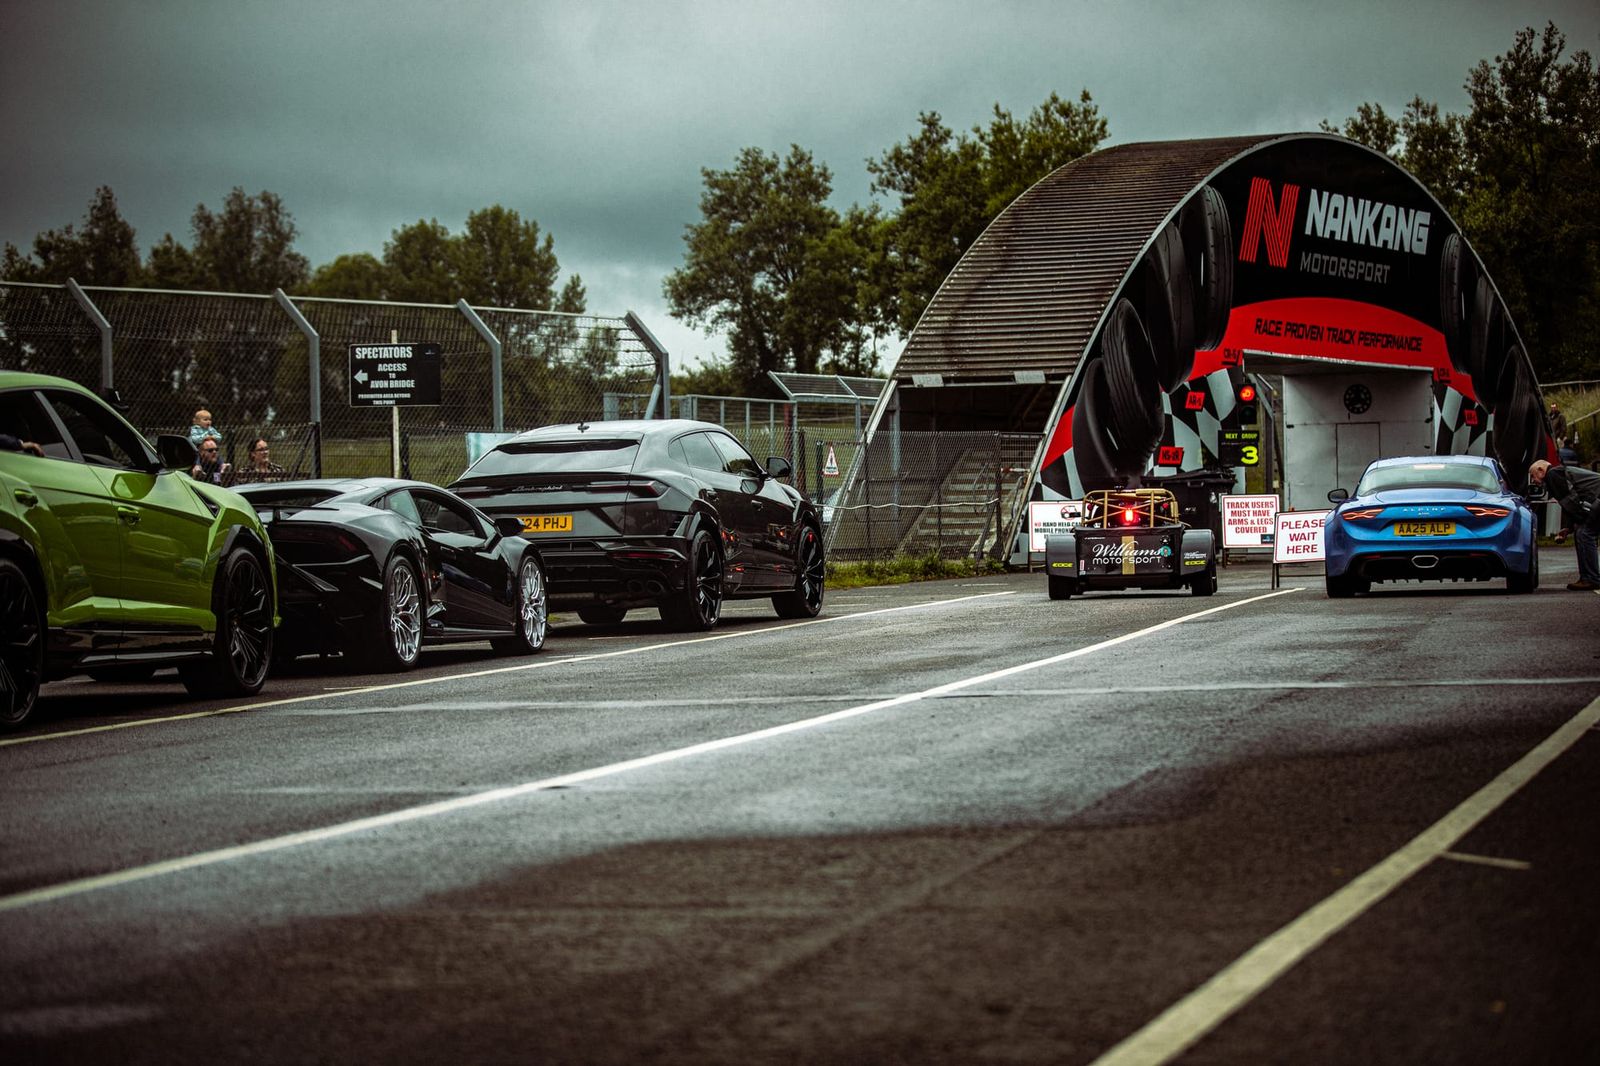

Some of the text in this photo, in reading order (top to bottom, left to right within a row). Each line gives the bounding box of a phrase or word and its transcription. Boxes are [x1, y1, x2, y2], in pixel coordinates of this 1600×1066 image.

[1304, 188, 1431, 256] NANKANG
[1300, 251, 1391, 284] MOTORSPORT
[1254, 317, 1423, 352] RACE PROVEN TRACK PERFORMANCE
[355, 346, 413, 359] SPECTATORS
[377, 363, 407, 372] ACCESS
[370, 379, 415, 388] AVON BRIDGE
[1241, 445, 1259, 465] 3
[1226, 501, 1275, 509] TRACK USERS
[1230, 509, 1271, 517] MUST HAVE
[522, 517, 567, 530] 24 PHJ
[1228, 518, 1249, 526] ARMS
[1281, 519, 1326, 530] PLEASE
[1235, 526, 1267, 534] COVERED
[1398, 523, 1451, 534] AA25 ALP
[1289, 532, 1318, 542] WAIT
[1092, 540, 1163, 557] Williams
[1286, 544, 1318, 555] HERE
